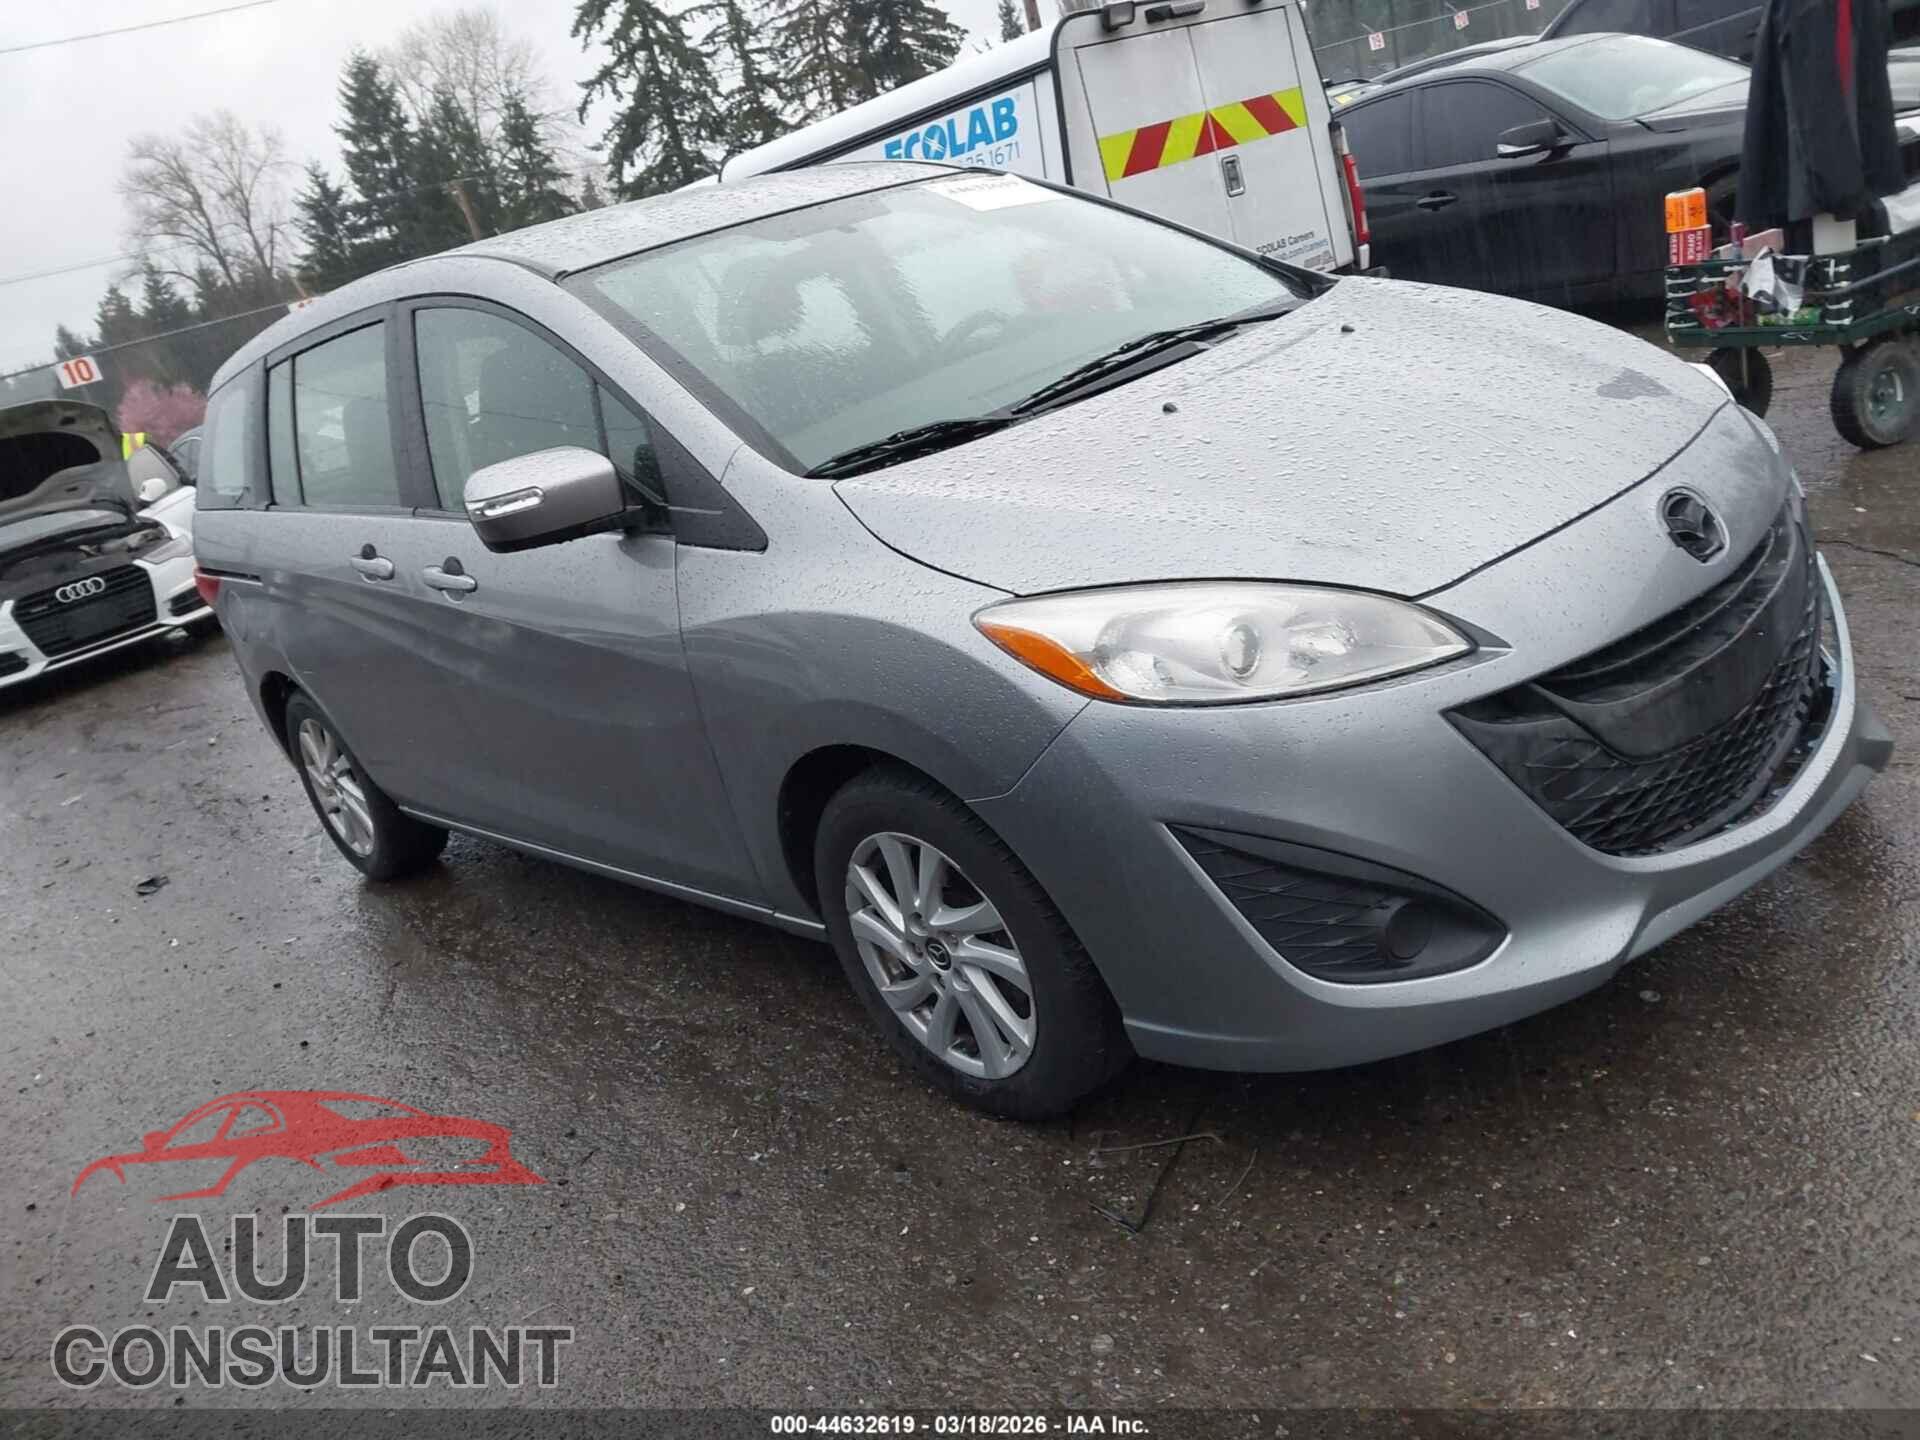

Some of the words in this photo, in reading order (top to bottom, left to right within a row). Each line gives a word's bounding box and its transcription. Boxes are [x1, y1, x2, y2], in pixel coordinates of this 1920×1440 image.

[884, 97, 1018, 160] ECOLAB
[1687, 233, 1696, 260] OFFICE
[64, 359, 93, 384] 10
